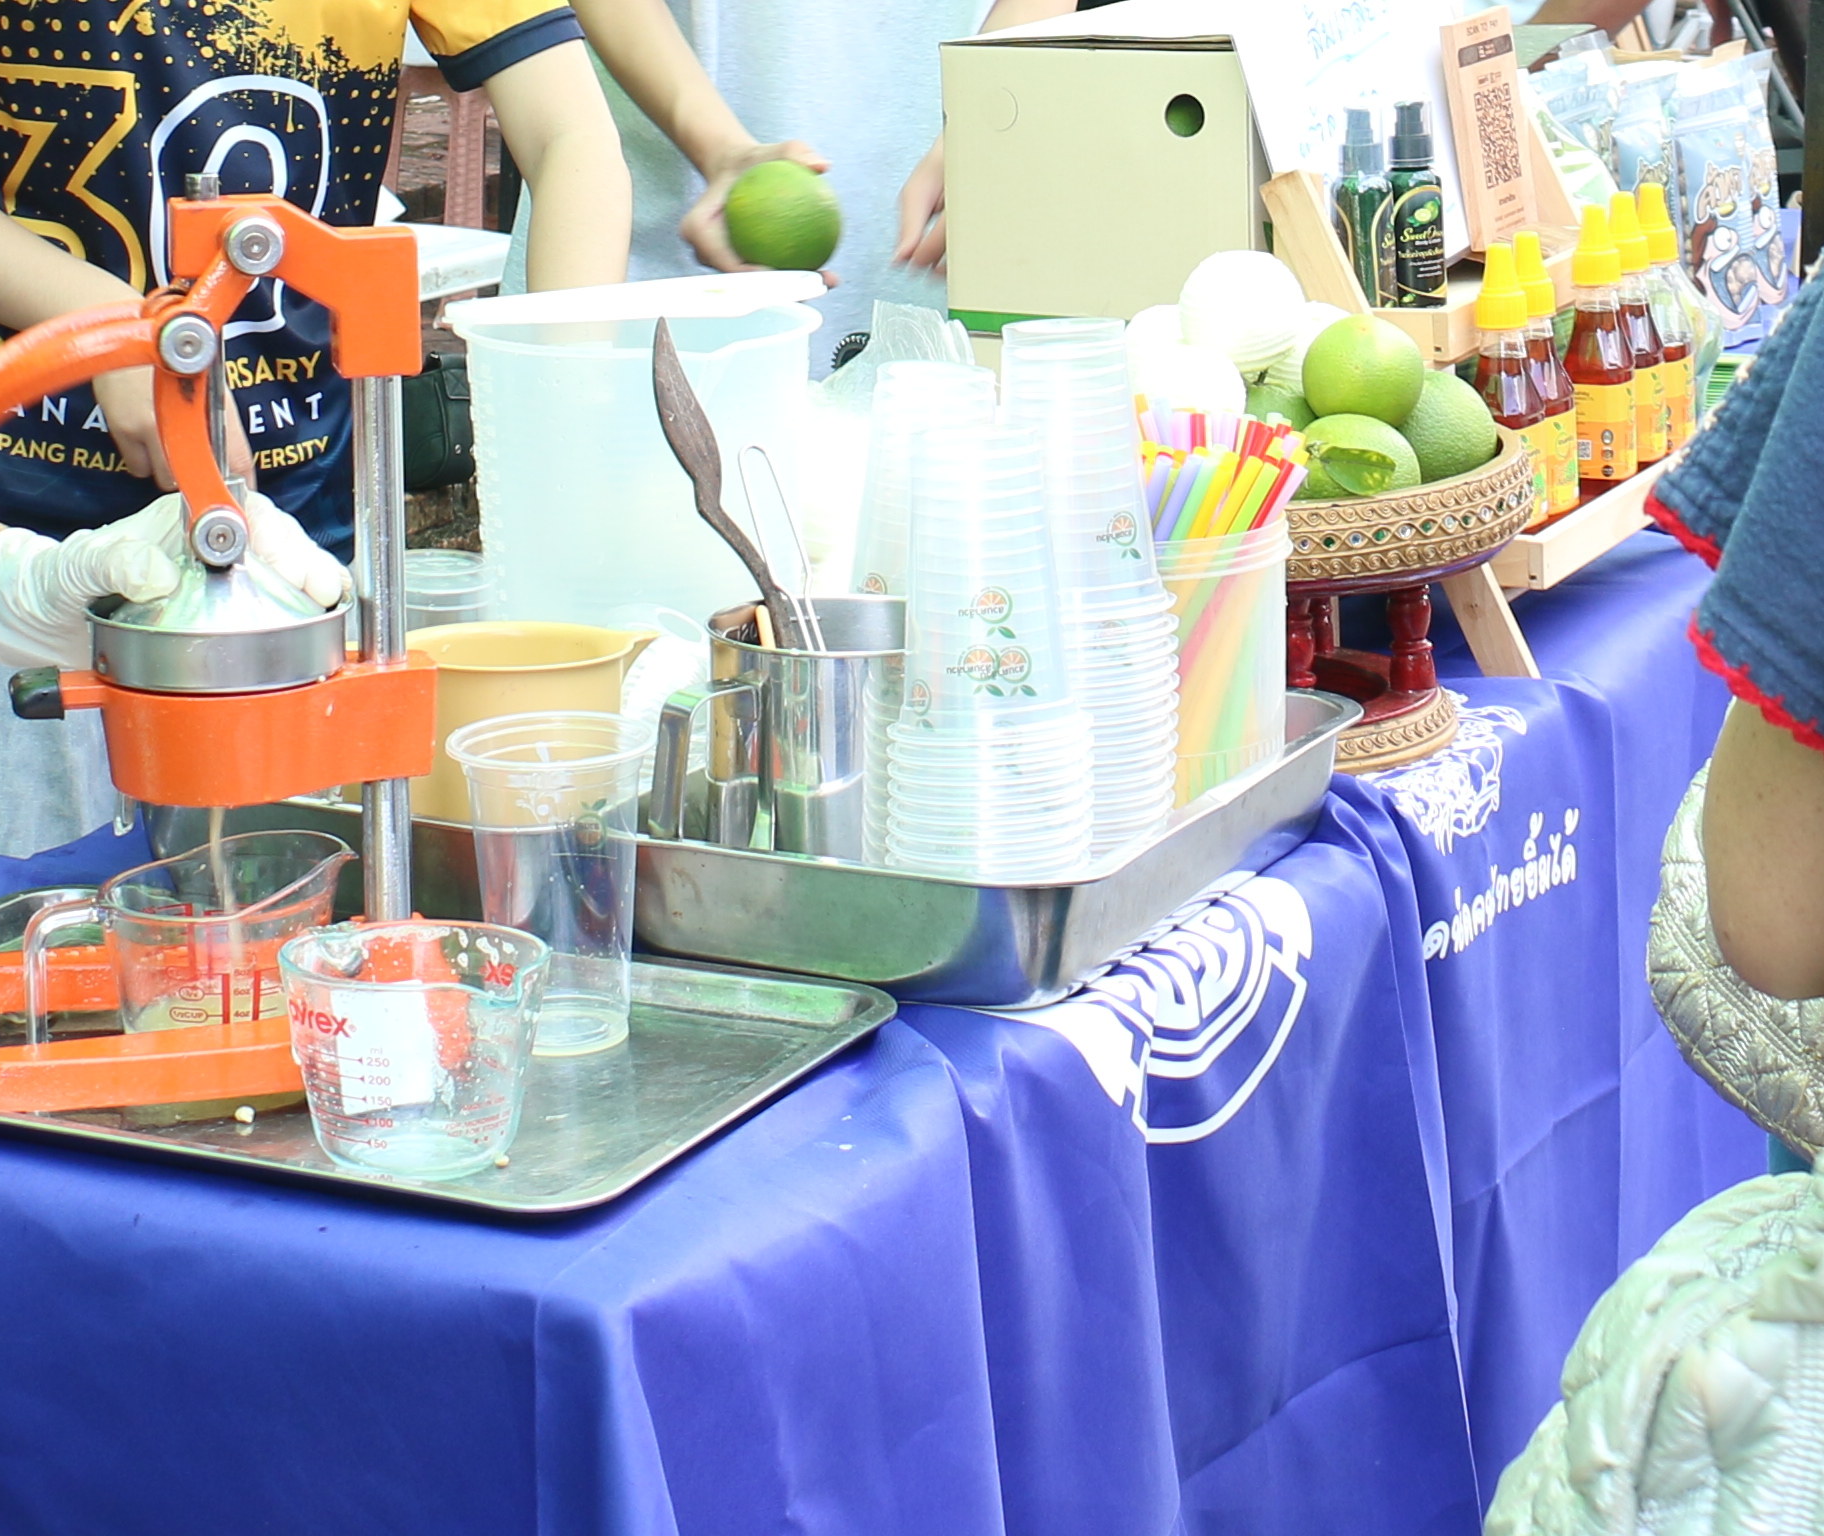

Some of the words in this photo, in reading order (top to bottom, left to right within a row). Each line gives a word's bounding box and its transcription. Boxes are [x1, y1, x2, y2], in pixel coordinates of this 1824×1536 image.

[366, 1056, 391, 1069] 250
[367, 1075, 392, 1087] 200
[370, 1095, 393, 1108] 150
